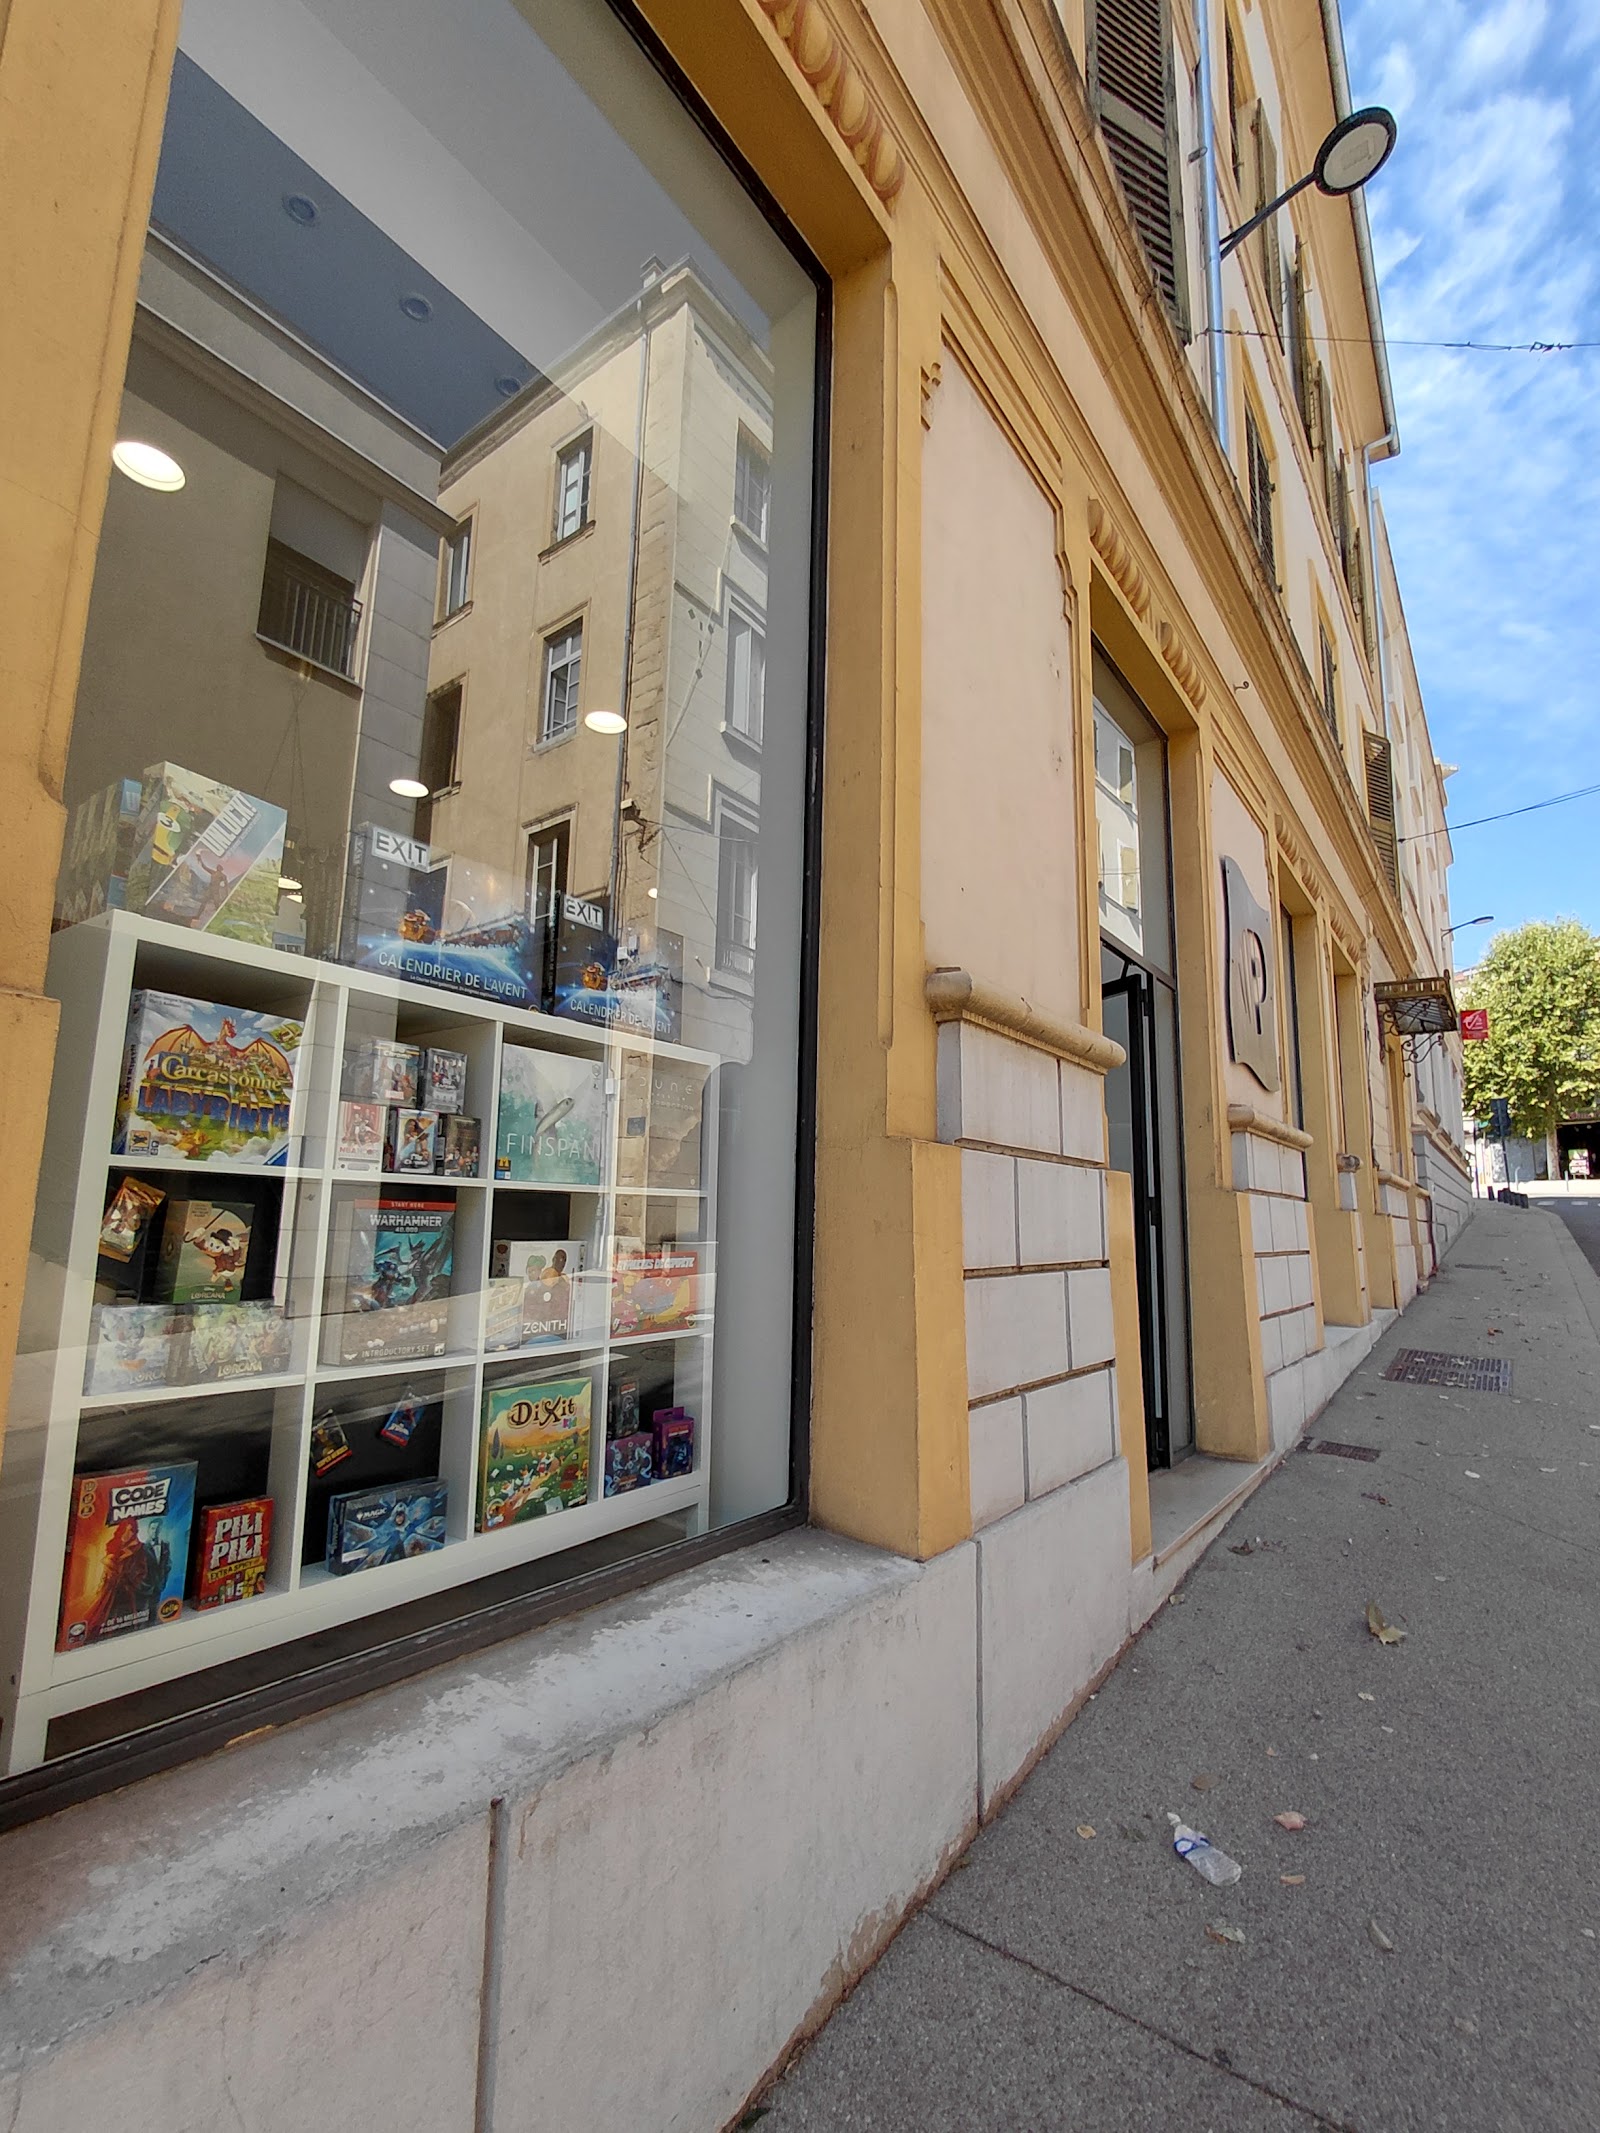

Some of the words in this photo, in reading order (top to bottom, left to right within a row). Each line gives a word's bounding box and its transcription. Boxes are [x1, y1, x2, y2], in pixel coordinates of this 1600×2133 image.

[159, 815, 173, 828] 3
[200, 791, 257, 857] UNLOCK!
[376, 831, 427, 864] EXIT
[566, 900, 601, 926] EXIT
[378, 952, 461, 984] CALENDRIER
[465, 973, 481, 988] DE
[483, 977, 528, 999] L'AVENT
[570, 999, 628, 1022] CALENDRIER
[629, 1013, 640, 1027] DE
[161, 1055, 282, 1091] Carcassonne
[506, 1133, 600, 1160] FINSPAN
[369, 1214, 442, 1227] WARHAMMER
[191, 1292, 226, 1300] LORCANA
[523, 1319, 567, 1334] ZENITH
[361, 1346, 415, 1358] INTRODUCTORY
[417, 1344, 430, 1354] SET
[217, 1360, 263, 1378] LORCANA
[115, 1482, 165, 1505] CODE
[113, 1499, 167, 1521] NAMES
[362, 1507, 387, 1518] MAGIC
[215, 1512, 264, 1543] PILI
[210, 1534, 263, 1569] PILI
[210, 1566, 233, 1580] EXTRA
